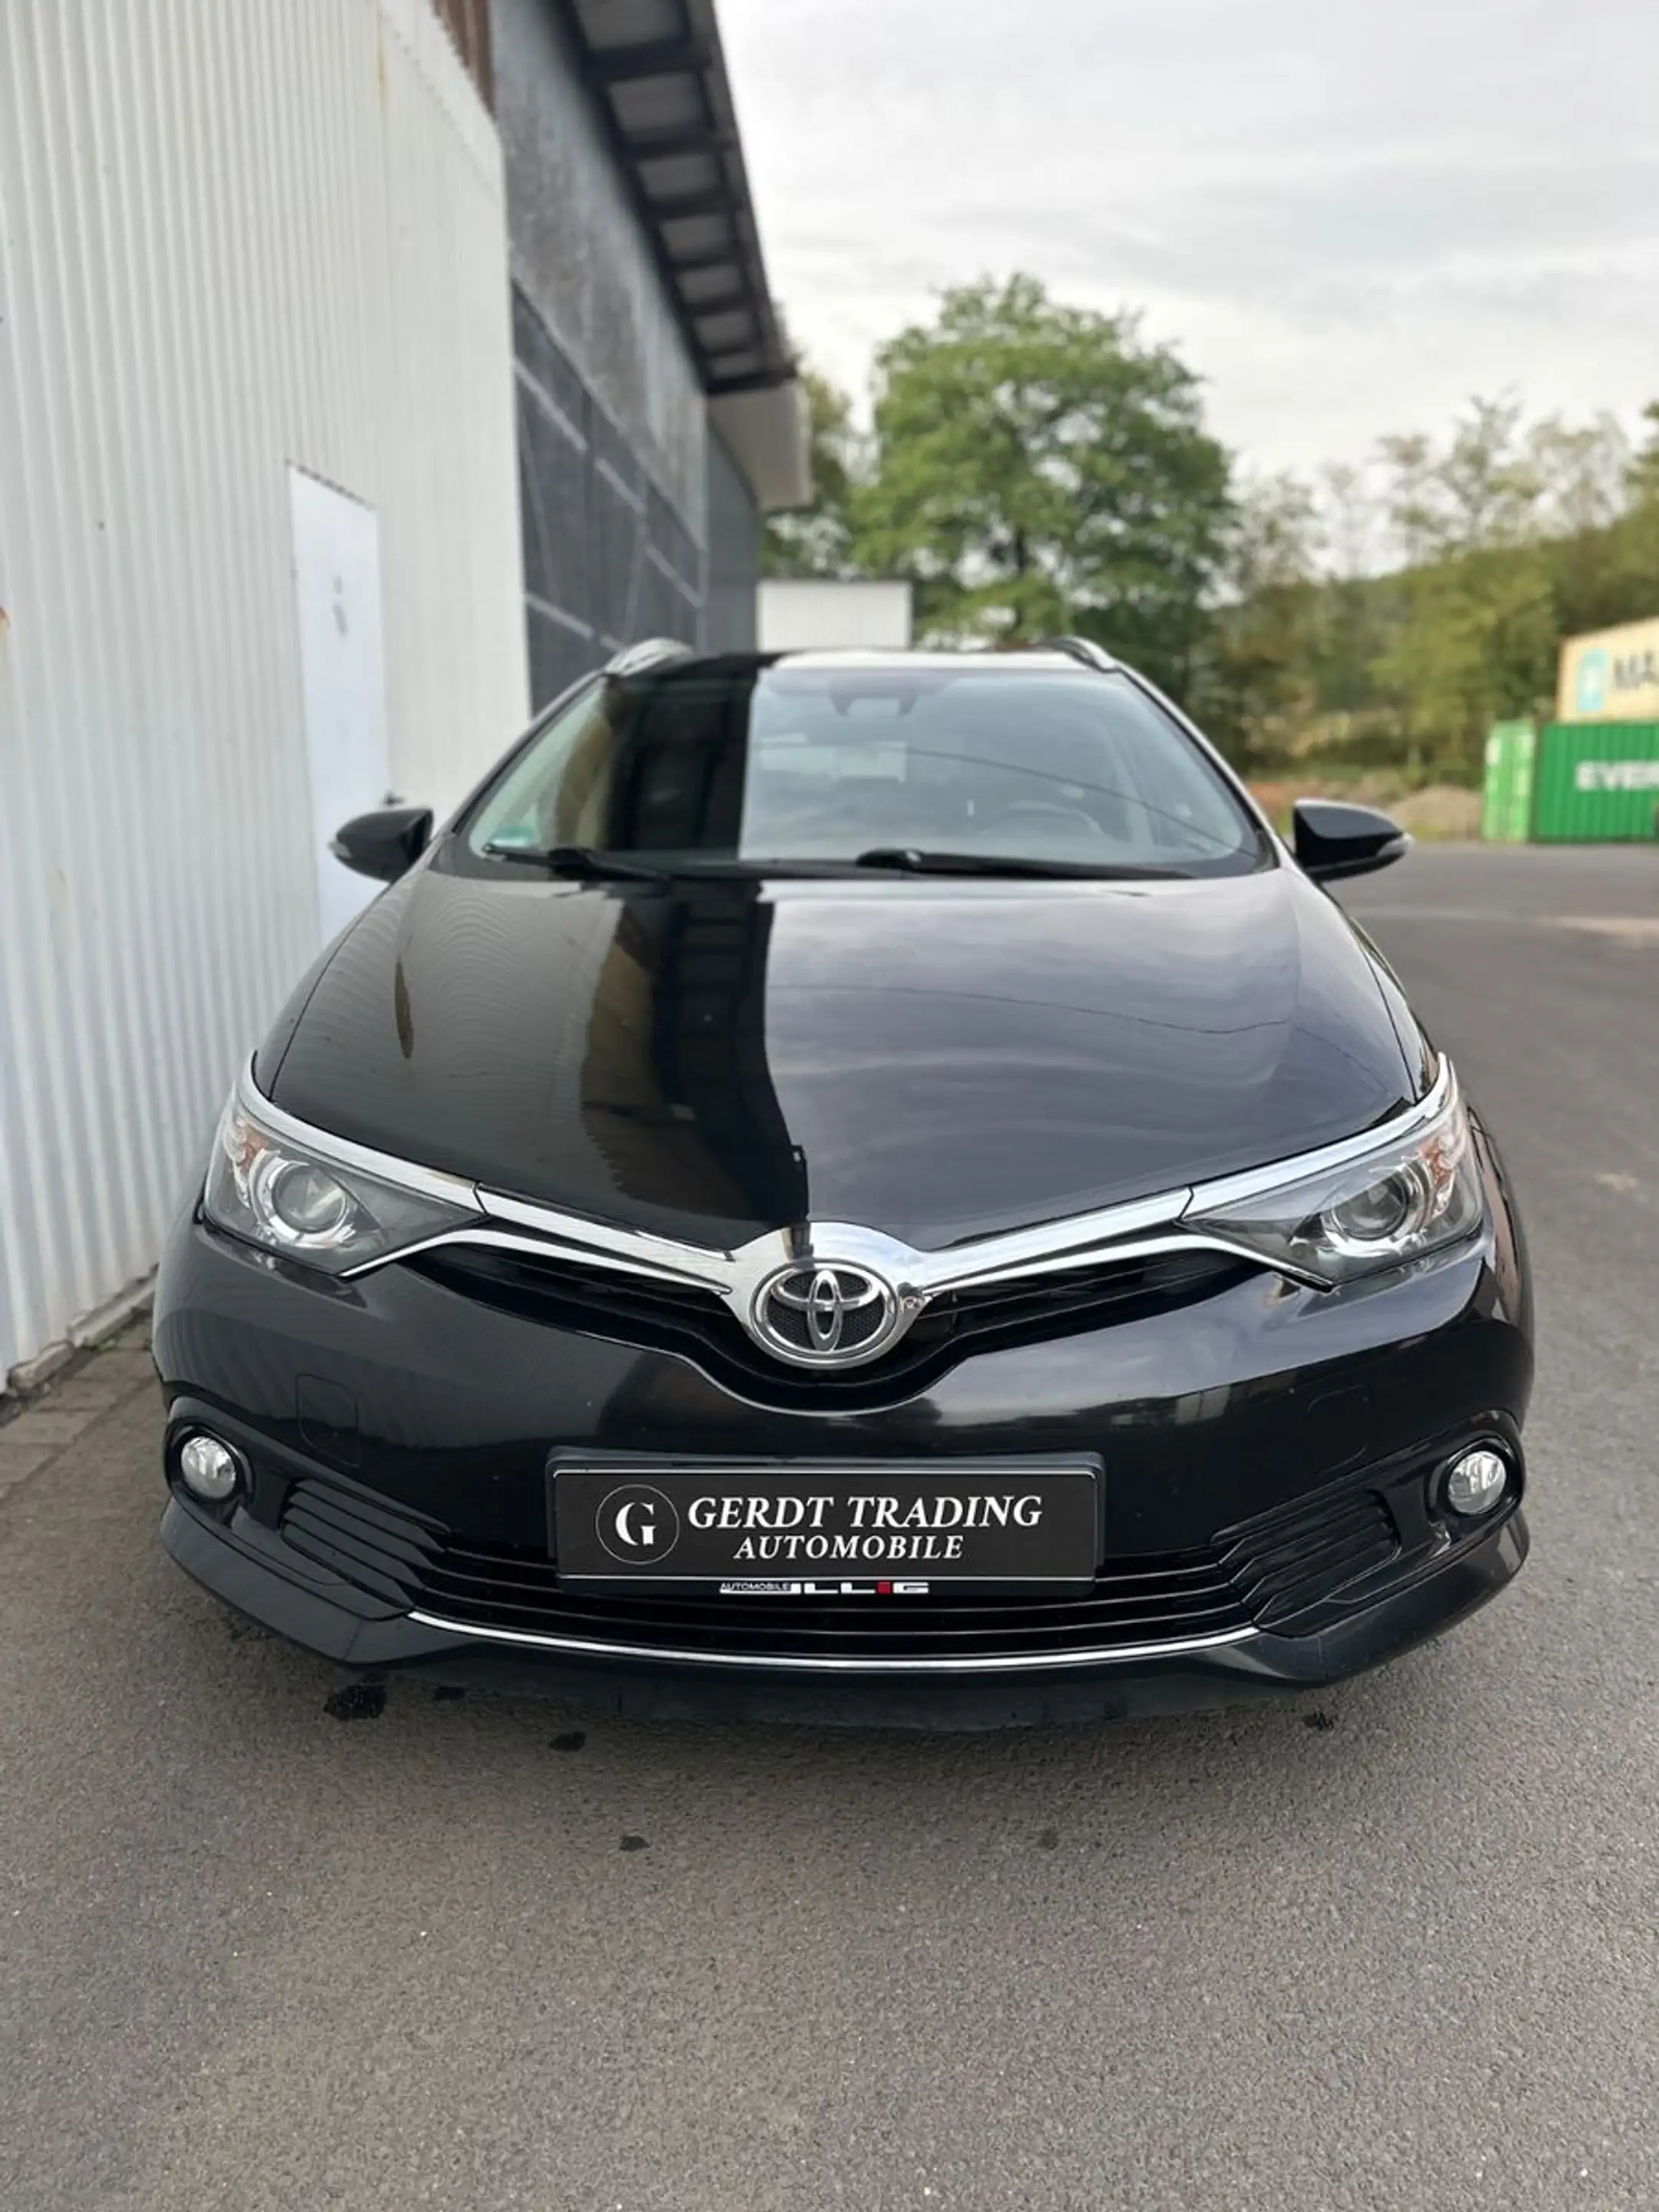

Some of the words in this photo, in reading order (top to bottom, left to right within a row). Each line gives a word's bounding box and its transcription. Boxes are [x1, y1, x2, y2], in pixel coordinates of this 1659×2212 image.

[614, 1502, 655, 1546] G
[687, 1496, 834, 1528] GERDT
[847, 1495, 1042, 1528] TRADING
[733, 1535, 964, 1559] AUTOMOBILE
[720, 1582, 790, 1592] AUTOMOBILE
